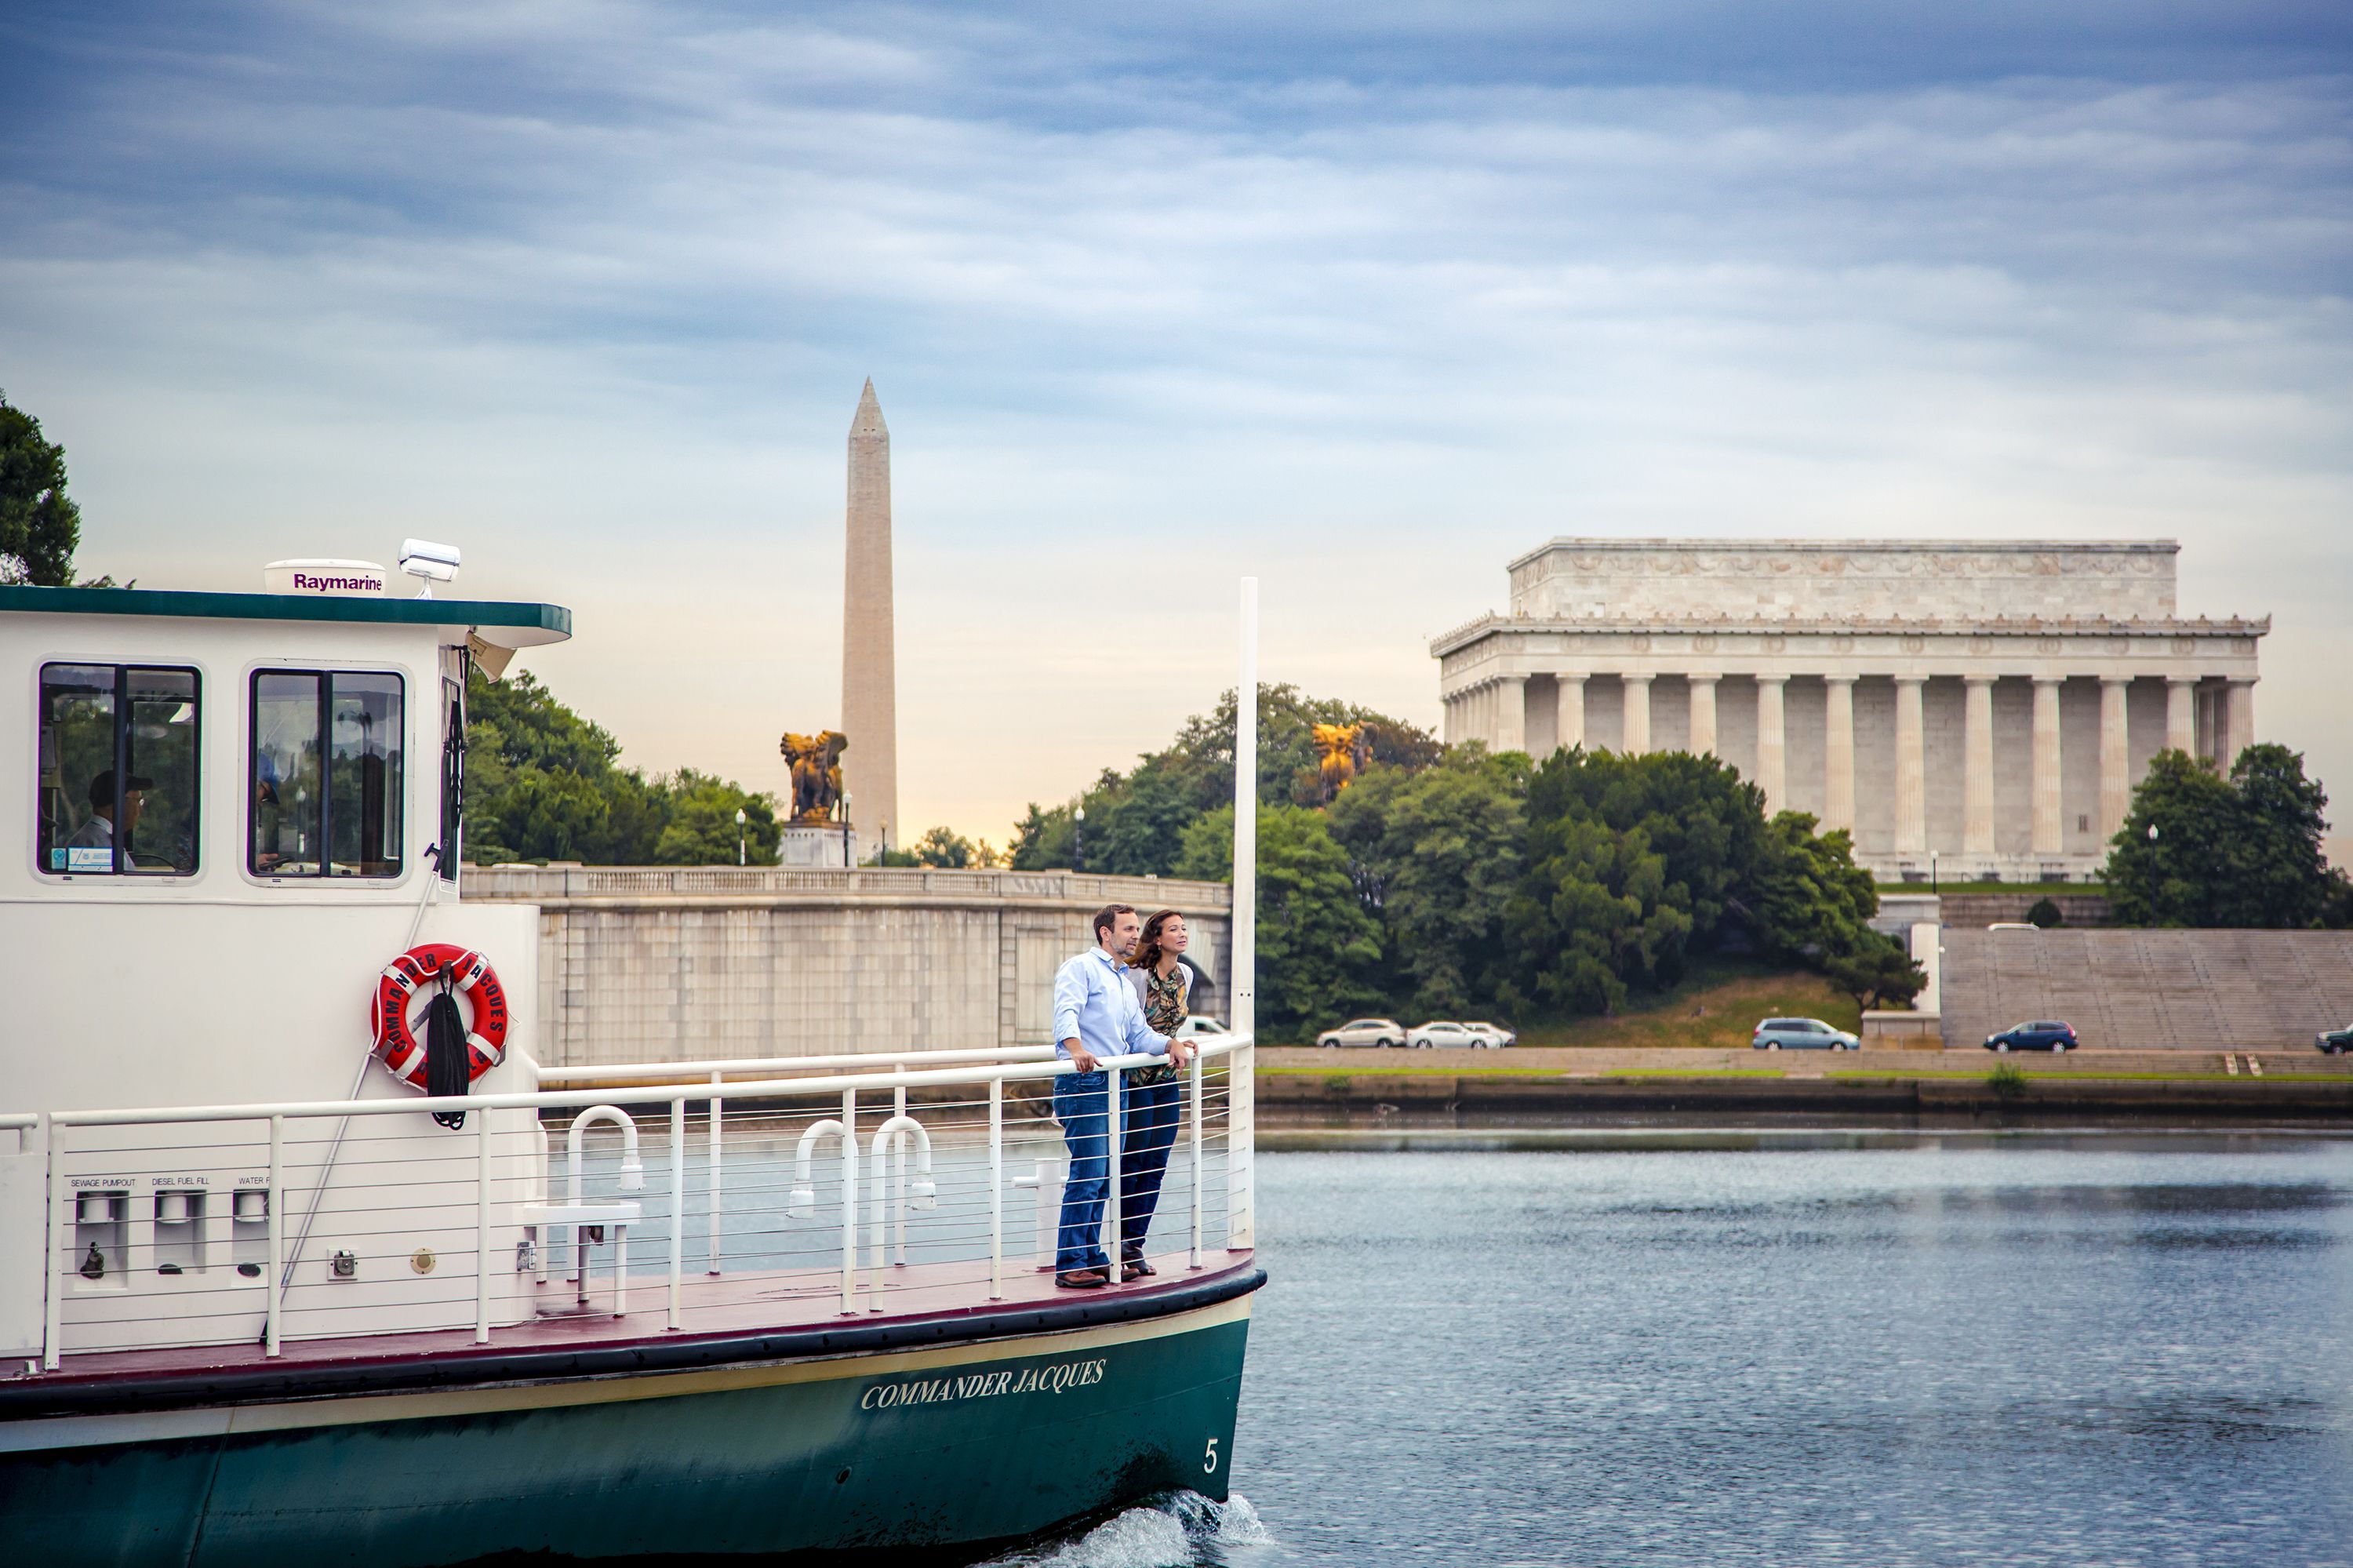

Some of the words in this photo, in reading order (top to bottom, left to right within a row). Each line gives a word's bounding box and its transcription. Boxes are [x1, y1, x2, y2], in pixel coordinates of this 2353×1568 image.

[293, 573, 382, 591] Raymarine
[385, 953, 437, 1053] COMMANDER
[463, 959, 504, 1032] JACQUES
[102, 1178, 136, 1187] PUMPOUT
[151, 1177, 176, 1186] DIESEL
[177, 1177, 195, 1185] FUEL
[860, 1371, 1013, 1410] COMMANDER
[1013, 1359, 1107, 1394] JACQUES
[1203, 1438, 1218, 1474] 5
